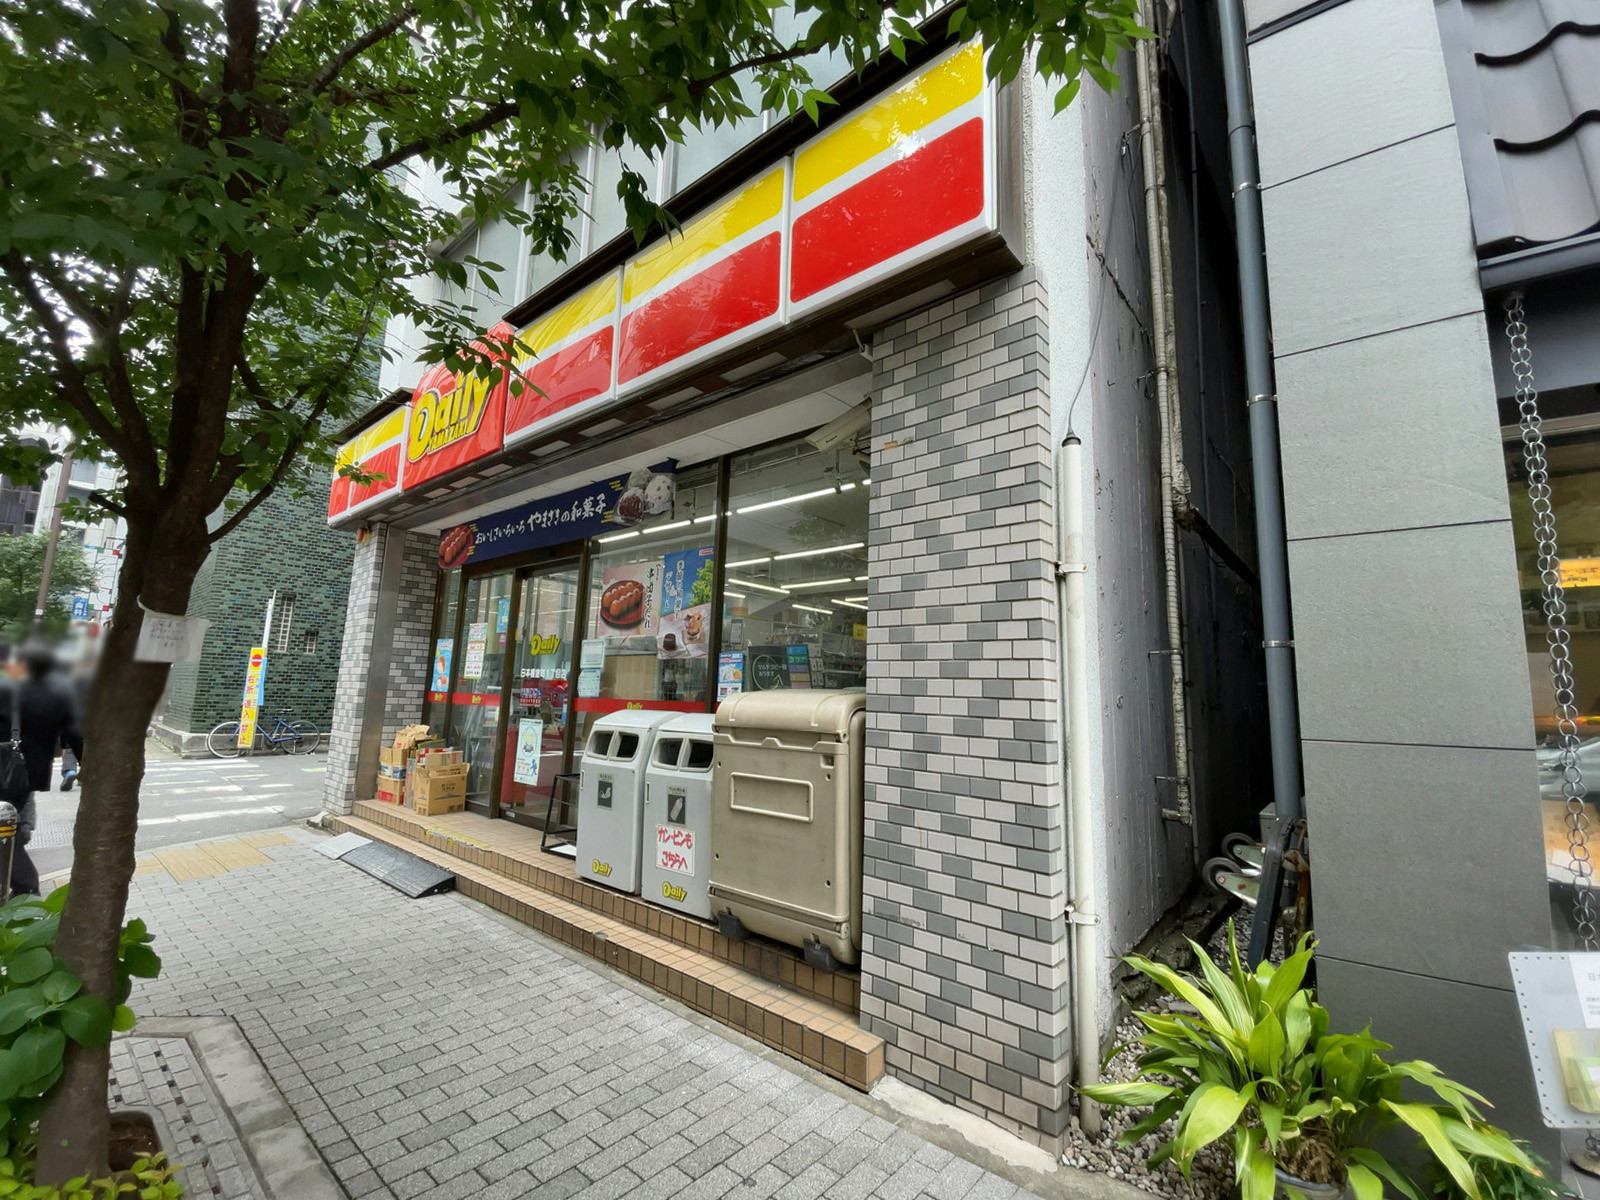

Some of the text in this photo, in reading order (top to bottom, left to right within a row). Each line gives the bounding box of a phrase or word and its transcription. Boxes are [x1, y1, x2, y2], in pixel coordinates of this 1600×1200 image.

[408, 368, 490, 461] Daily
[428, 420, 469, 453] YAMAZAKI
[530, 634, 561, 656] Daily
[592, 859, 612, 878] Daily
[661, 850, 688, 870] こちらへ
[662, 881, 688, 903] Daily
